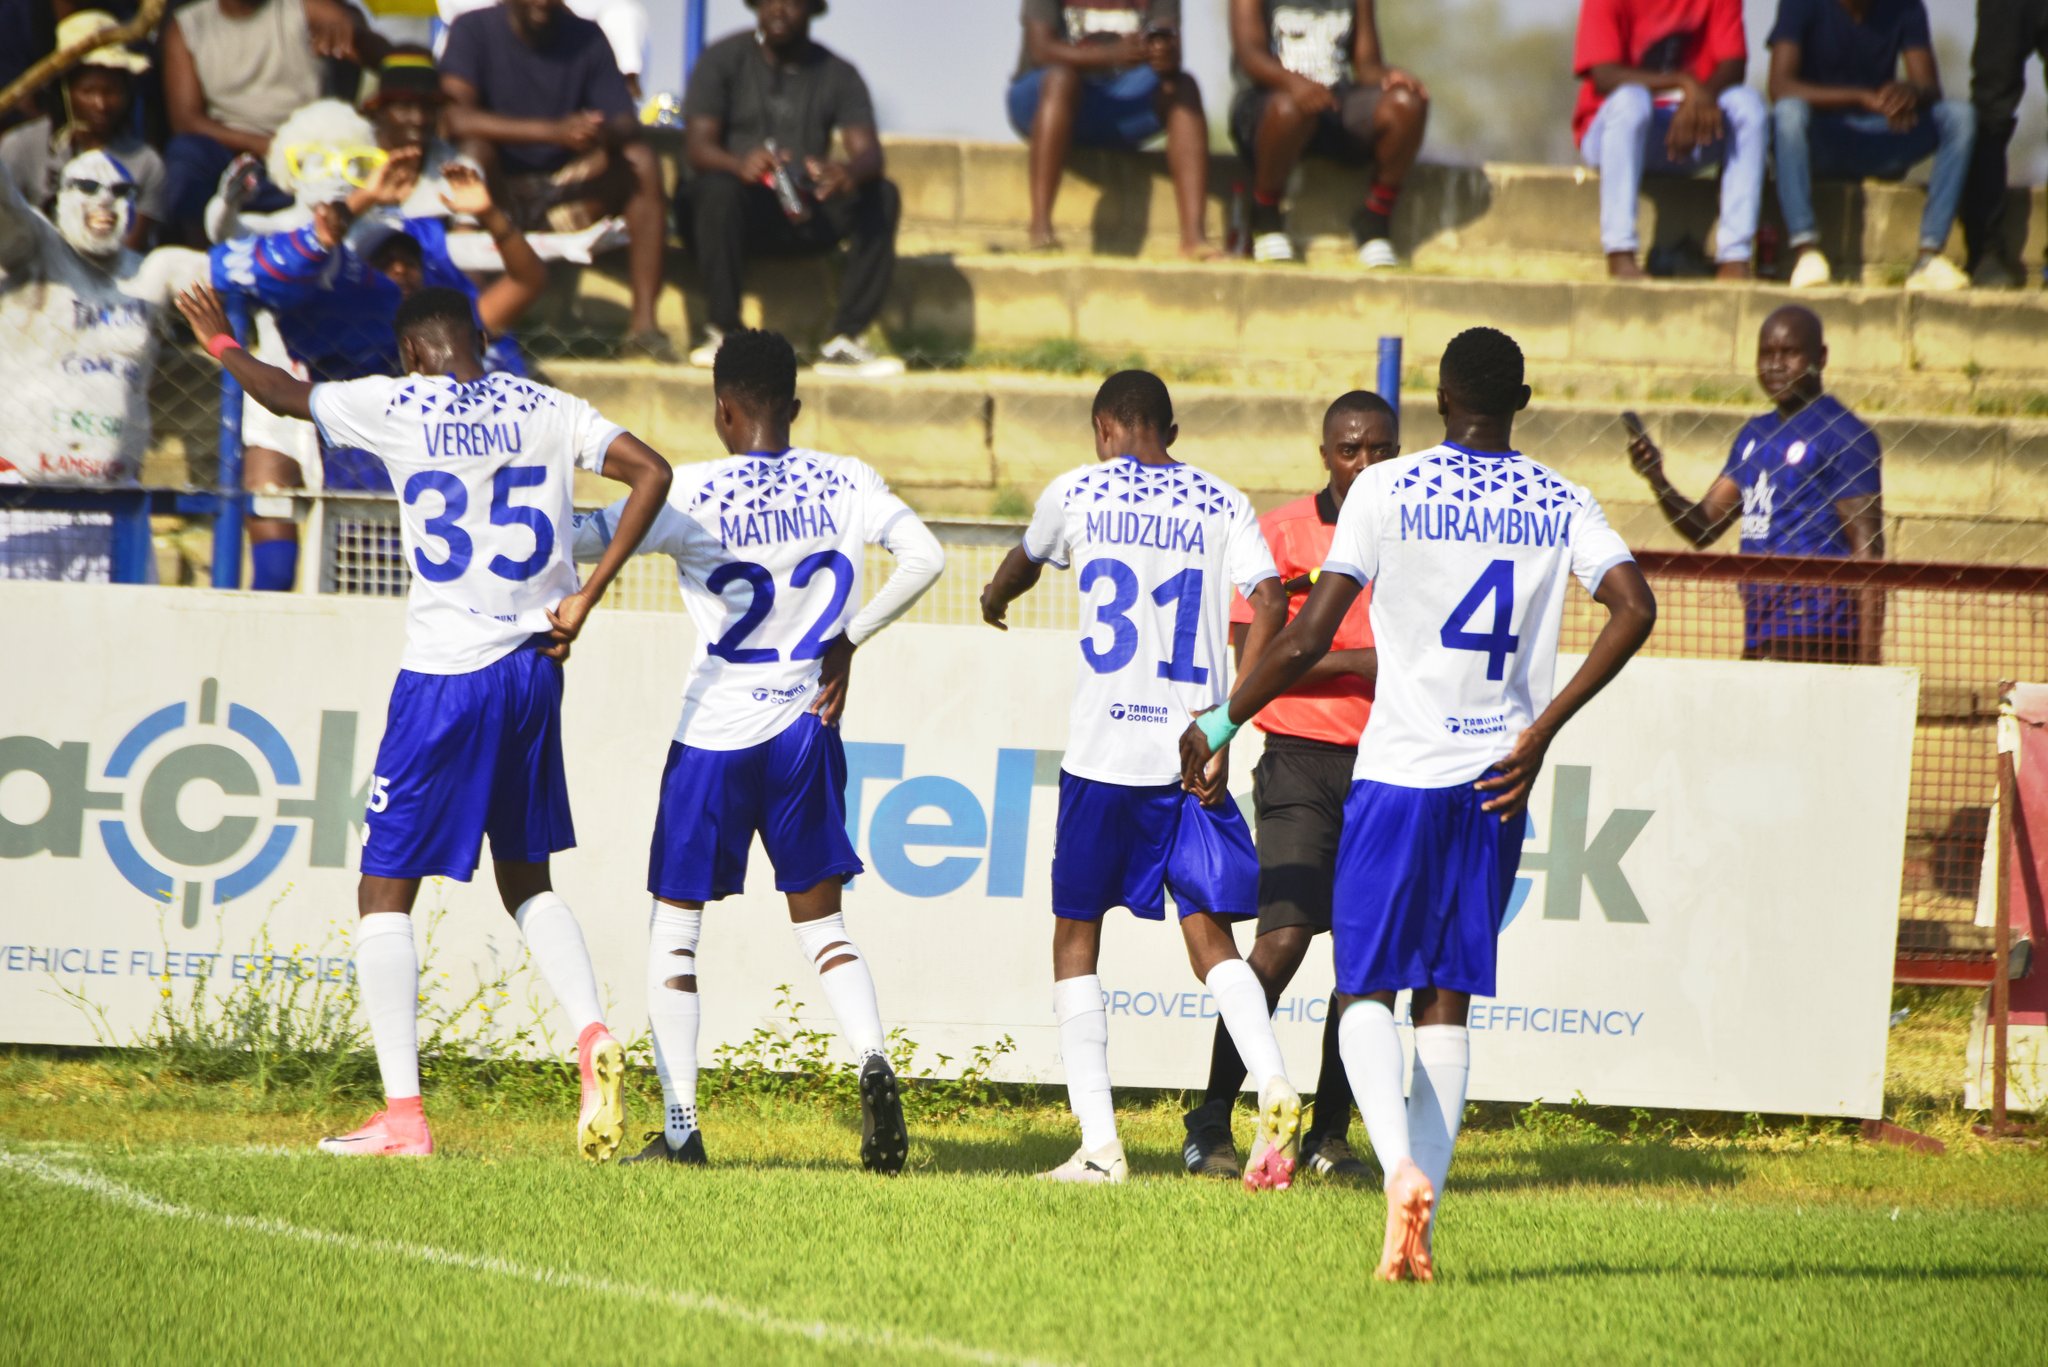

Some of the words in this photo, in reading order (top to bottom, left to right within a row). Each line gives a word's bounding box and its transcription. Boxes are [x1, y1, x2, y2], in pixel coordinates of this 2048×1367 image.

[424, 422, 522, 457] VEREMU
[404, 465, 555, 582] 35
[720, 504, 838, 550] MATINHA
[1086, 511, 1205, 554] MUDZUKA
[706, 550, 855, 664] 22
[1079, 557, 1209, 686] 31
[1440, 559, 1519, 681] 4
[1127, 714, 1168, 724] COACHES
[1128, 704, 1168, 715] TAMUKA
[129, 950, 222, 978] FLEET
[1469, 1004, 1644, 1036] EFFICIENCY
